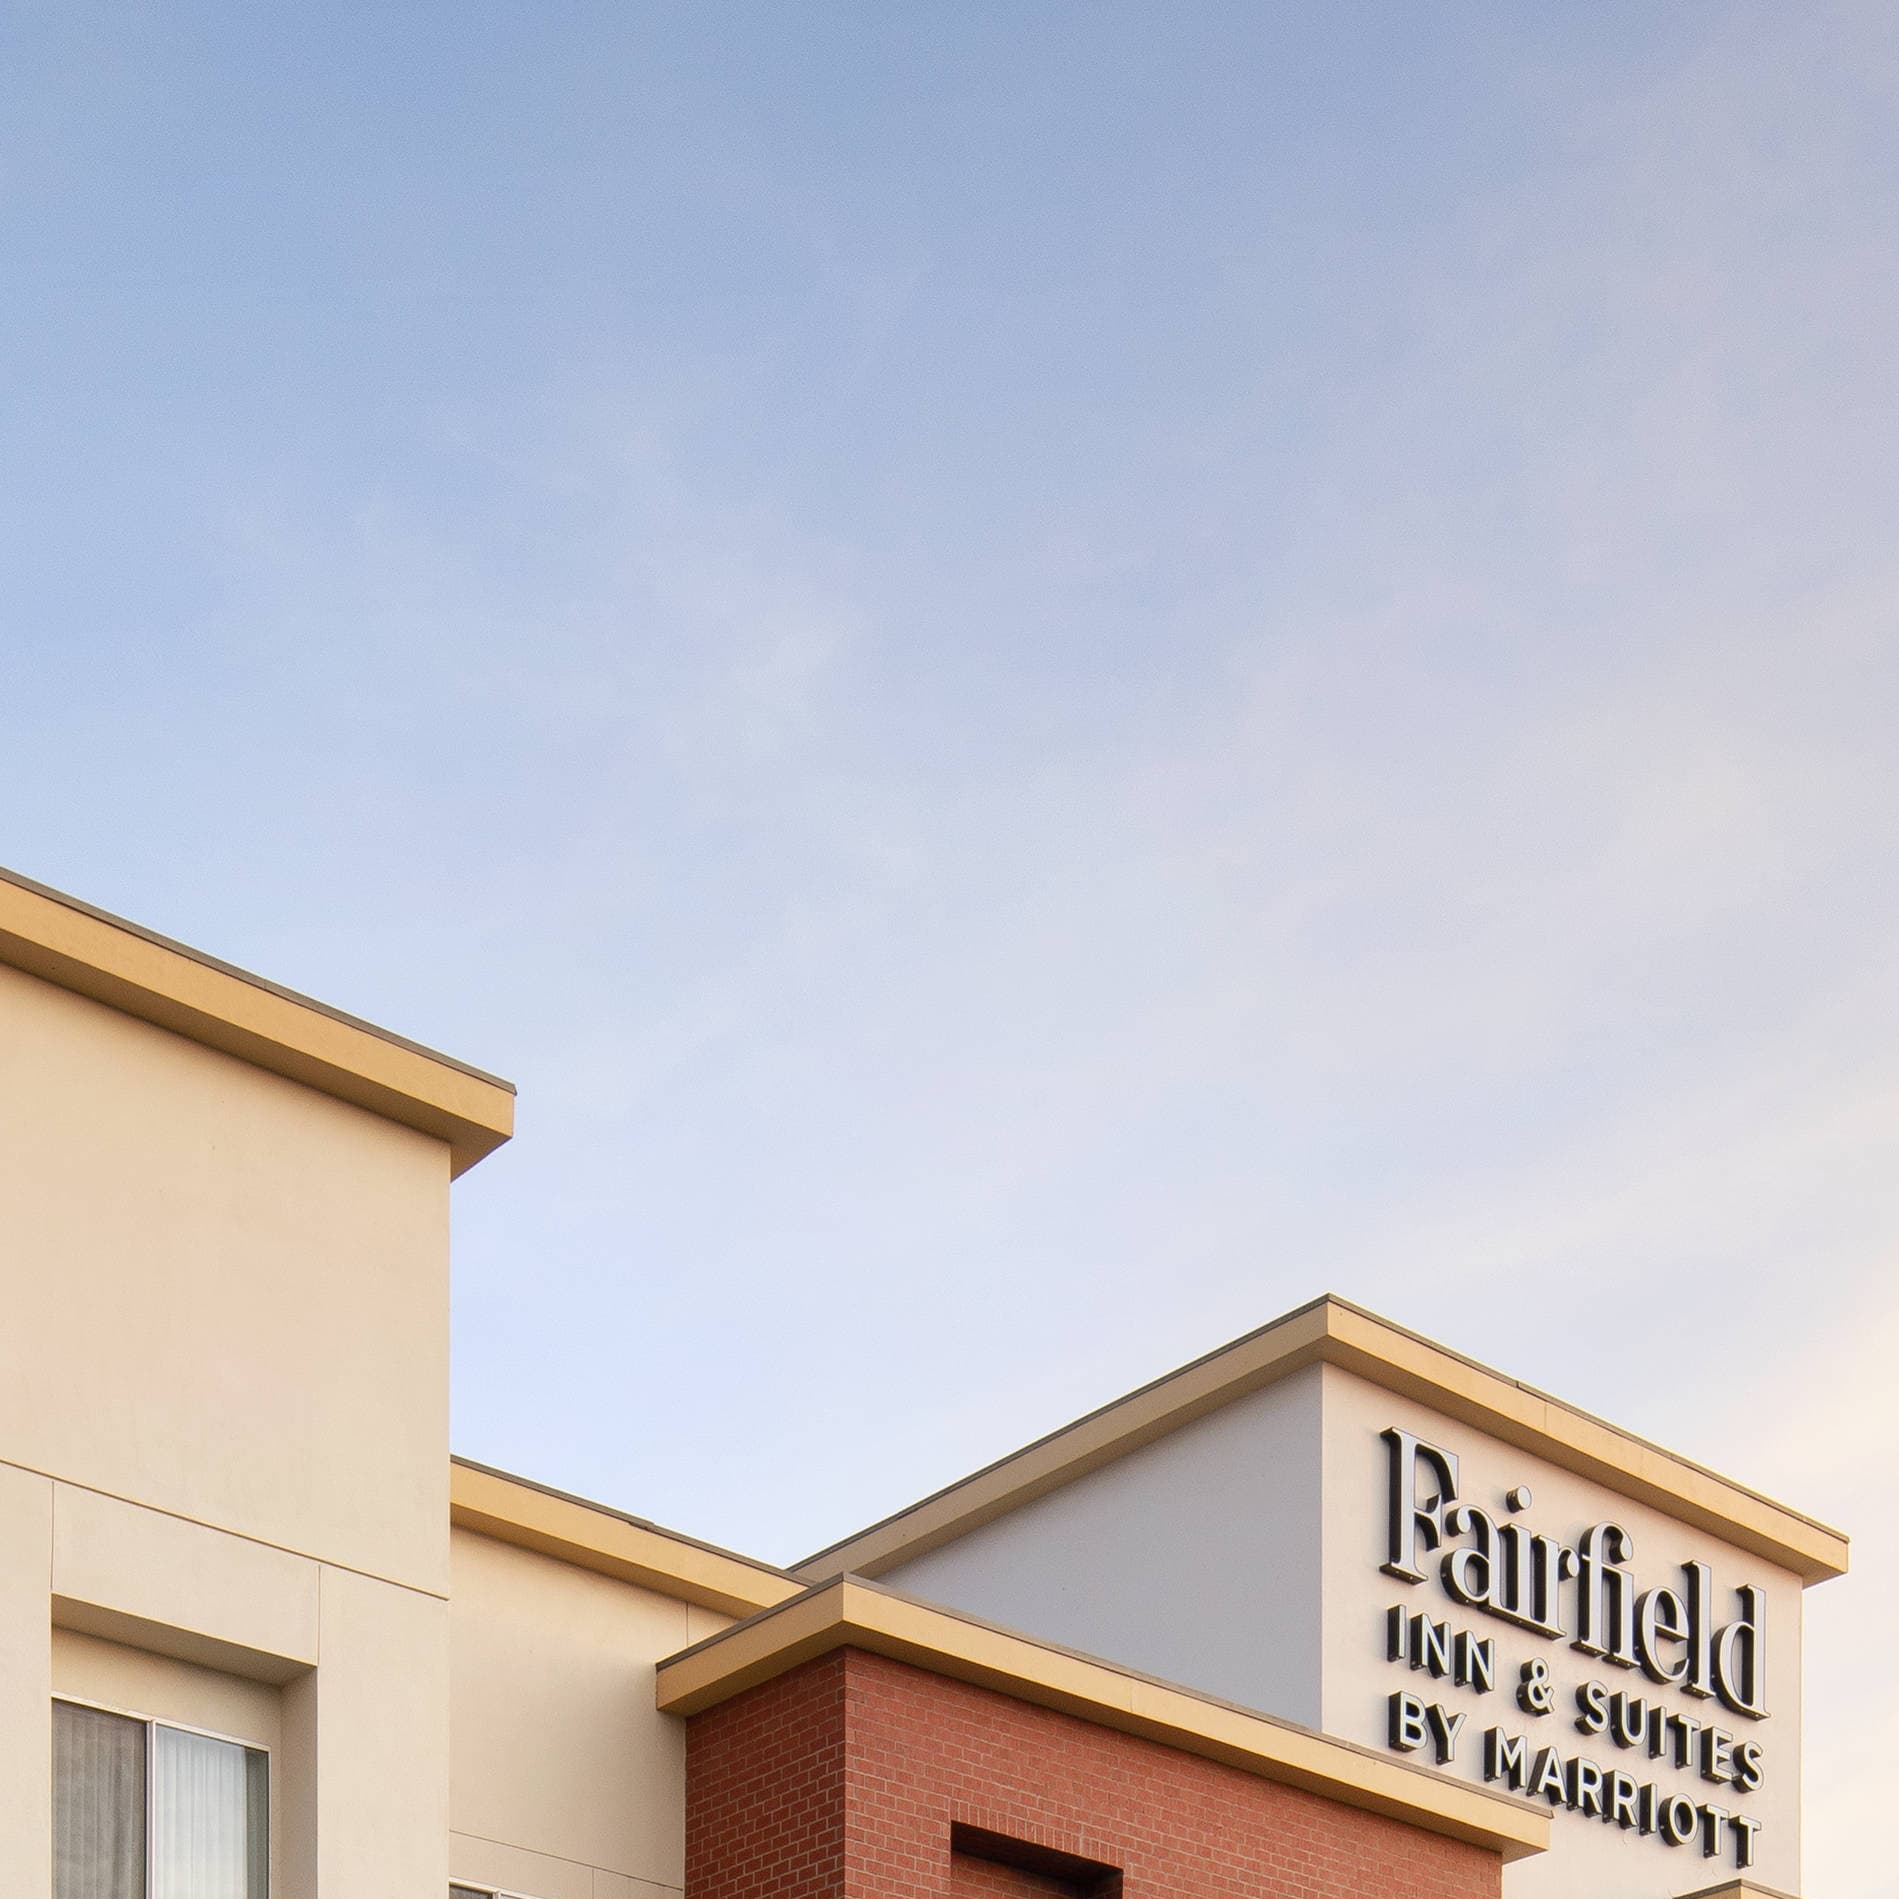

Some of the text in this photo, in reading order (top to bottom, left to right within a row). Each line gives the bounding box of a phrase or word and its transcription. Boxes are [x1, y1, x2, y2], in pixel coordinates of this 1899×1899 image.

[1380, 1427, 1771, 1721] Fairfield
[1387, 1604, 1764, 1793] INN & SUITES
[1389, 1690, 1762, 1868] BY MARRIOTT
